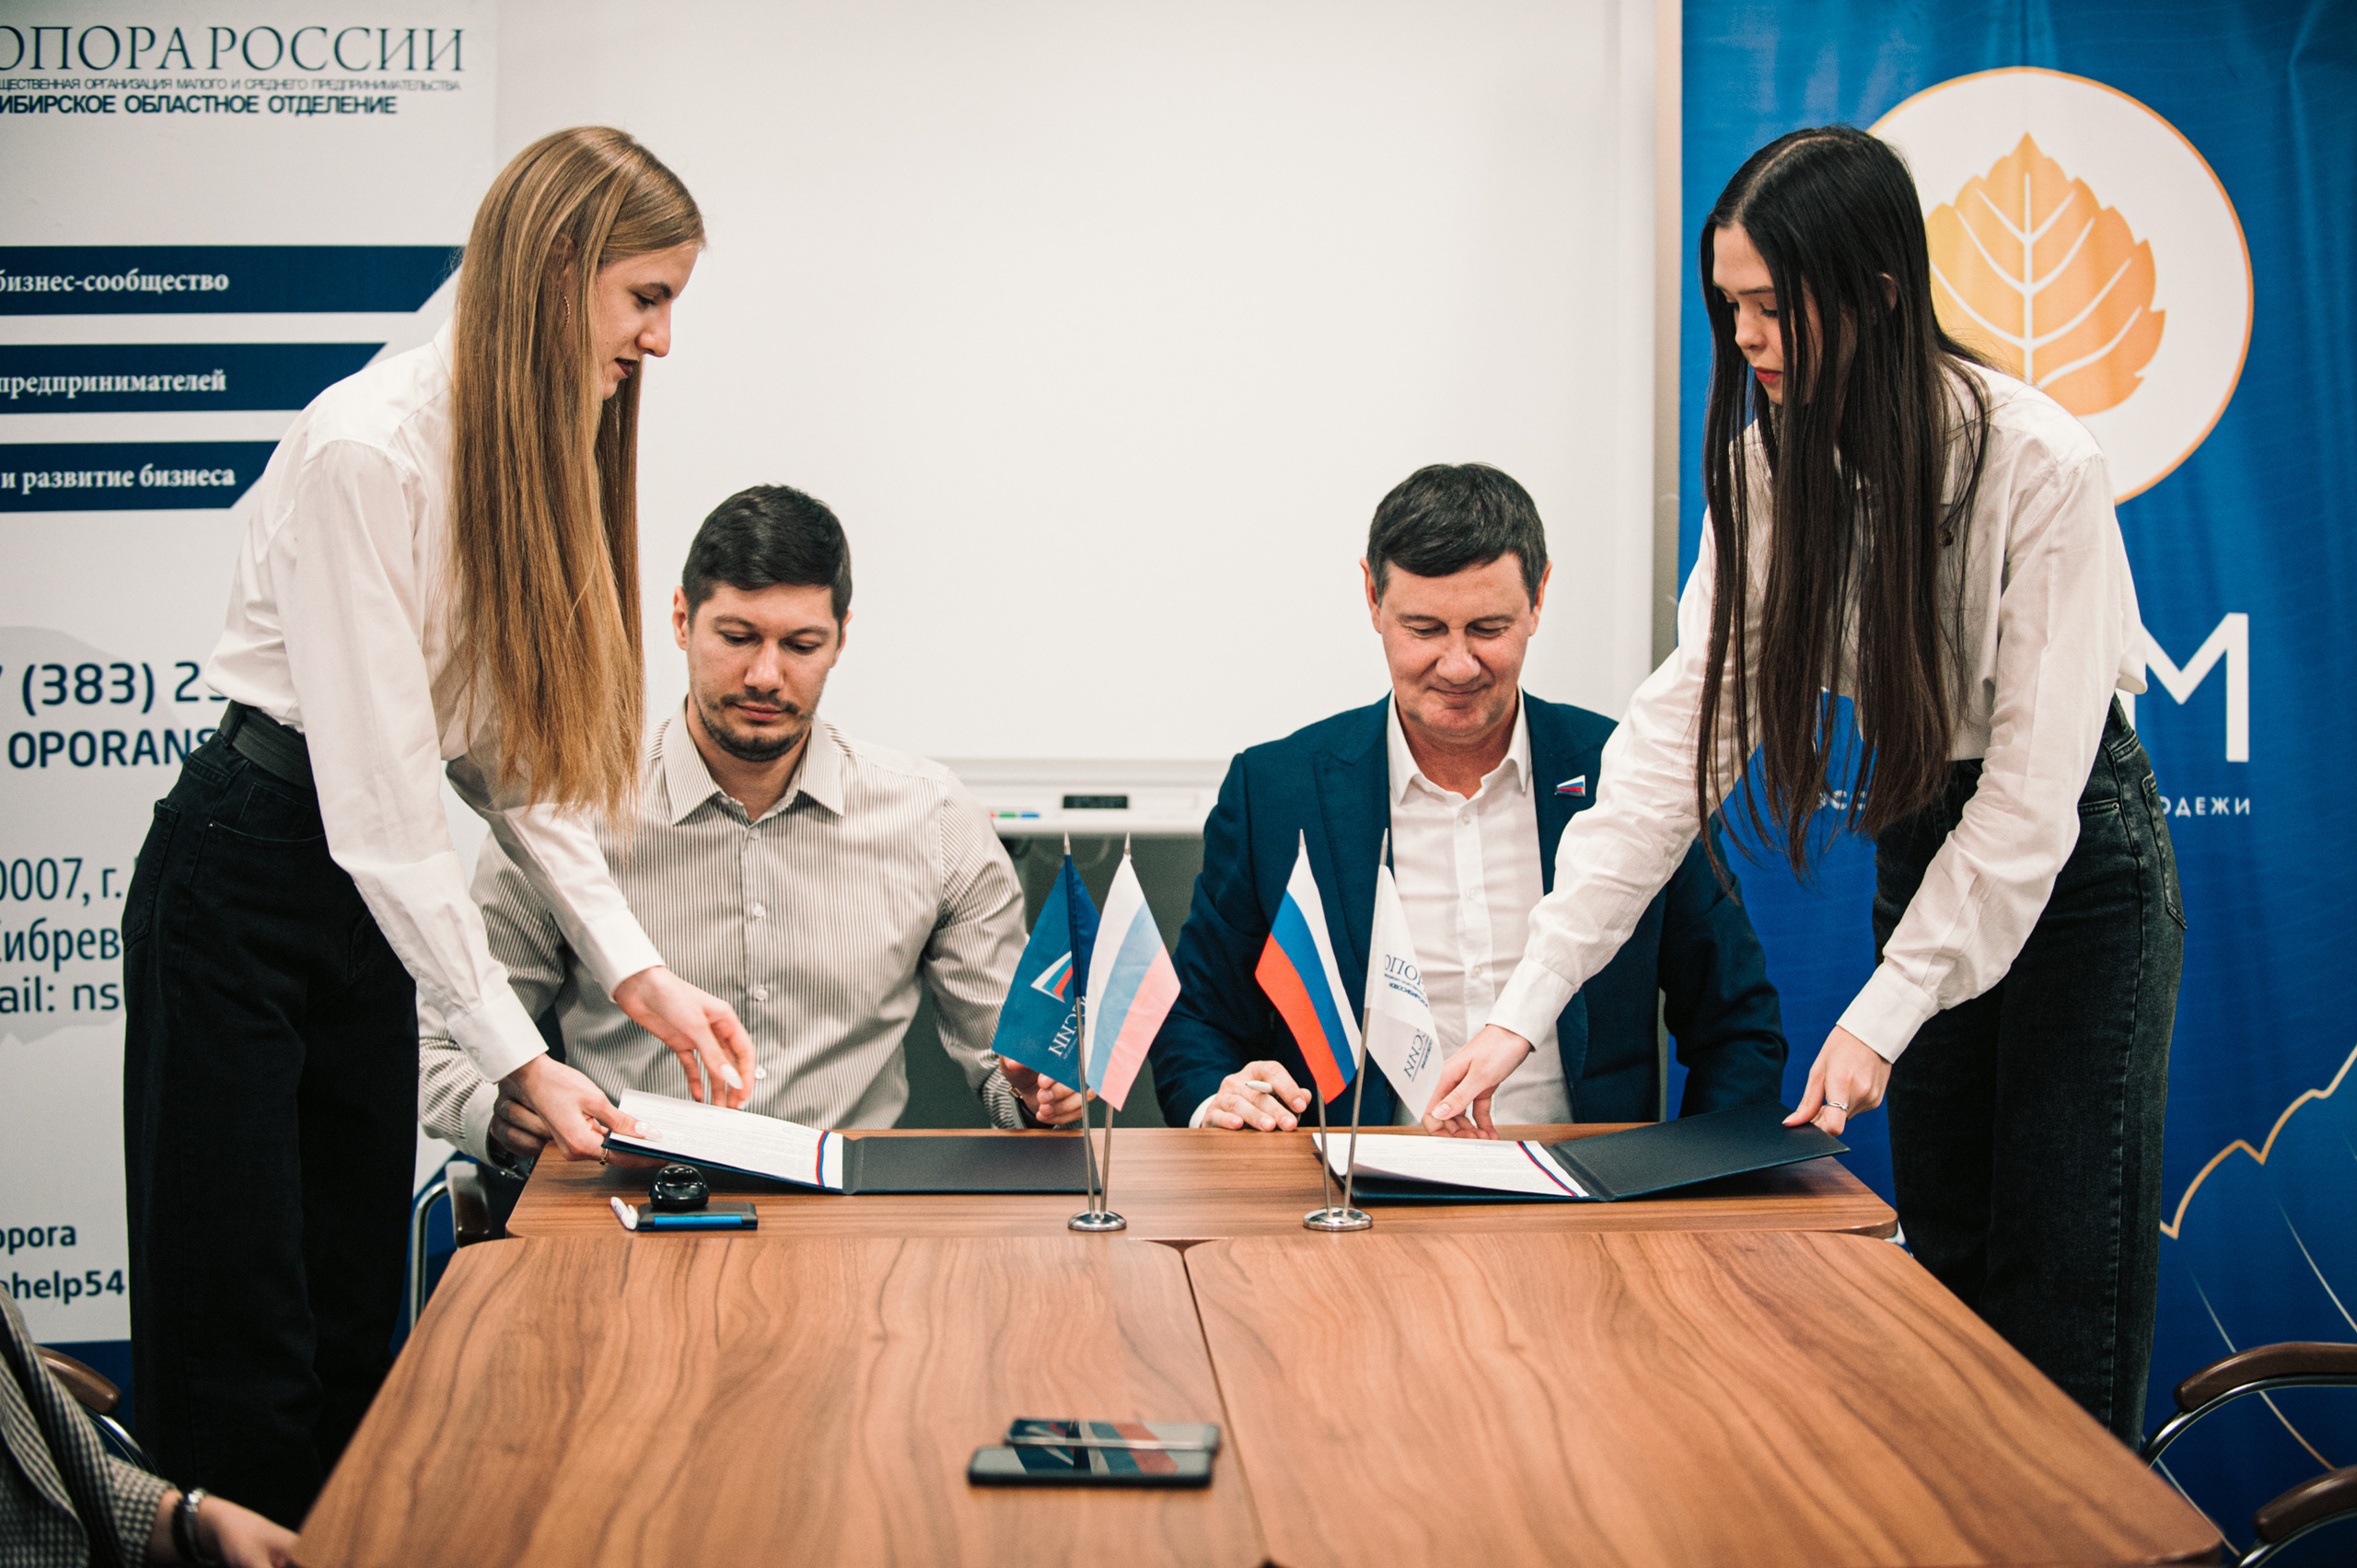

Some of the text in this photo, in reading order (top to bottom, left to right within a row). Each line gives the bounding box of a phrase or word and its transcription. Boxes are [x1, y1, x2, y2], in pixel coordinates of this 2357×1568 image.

[0, 25, 465, 72] ОПОРА РОССИИ
[85, 78, 173, 91] ОРГАНИЗАЦИЯ
[177, 78, 227, 90] МАЛОГО
[231, 78, 240, 90] И
[244, 78, 308, 91] СРЕДНЕГО
[311, 78, 461, 92] ПРЕДПРИНИМАТЕЛЬСТВА
[0, 95, 398, 116] ИБИРСКОЕ ОБЛАСТНОЕ ОТДЕЛЕНИЕ
[0, 368, 226, 400] предпринимателей
[1, 462, 237, 495] и развитие бизнеса
[22, 661, 230, 716] (383) 2
[102, 867, 122, 899] г.
[0, 917, 121, 972] ибрев
